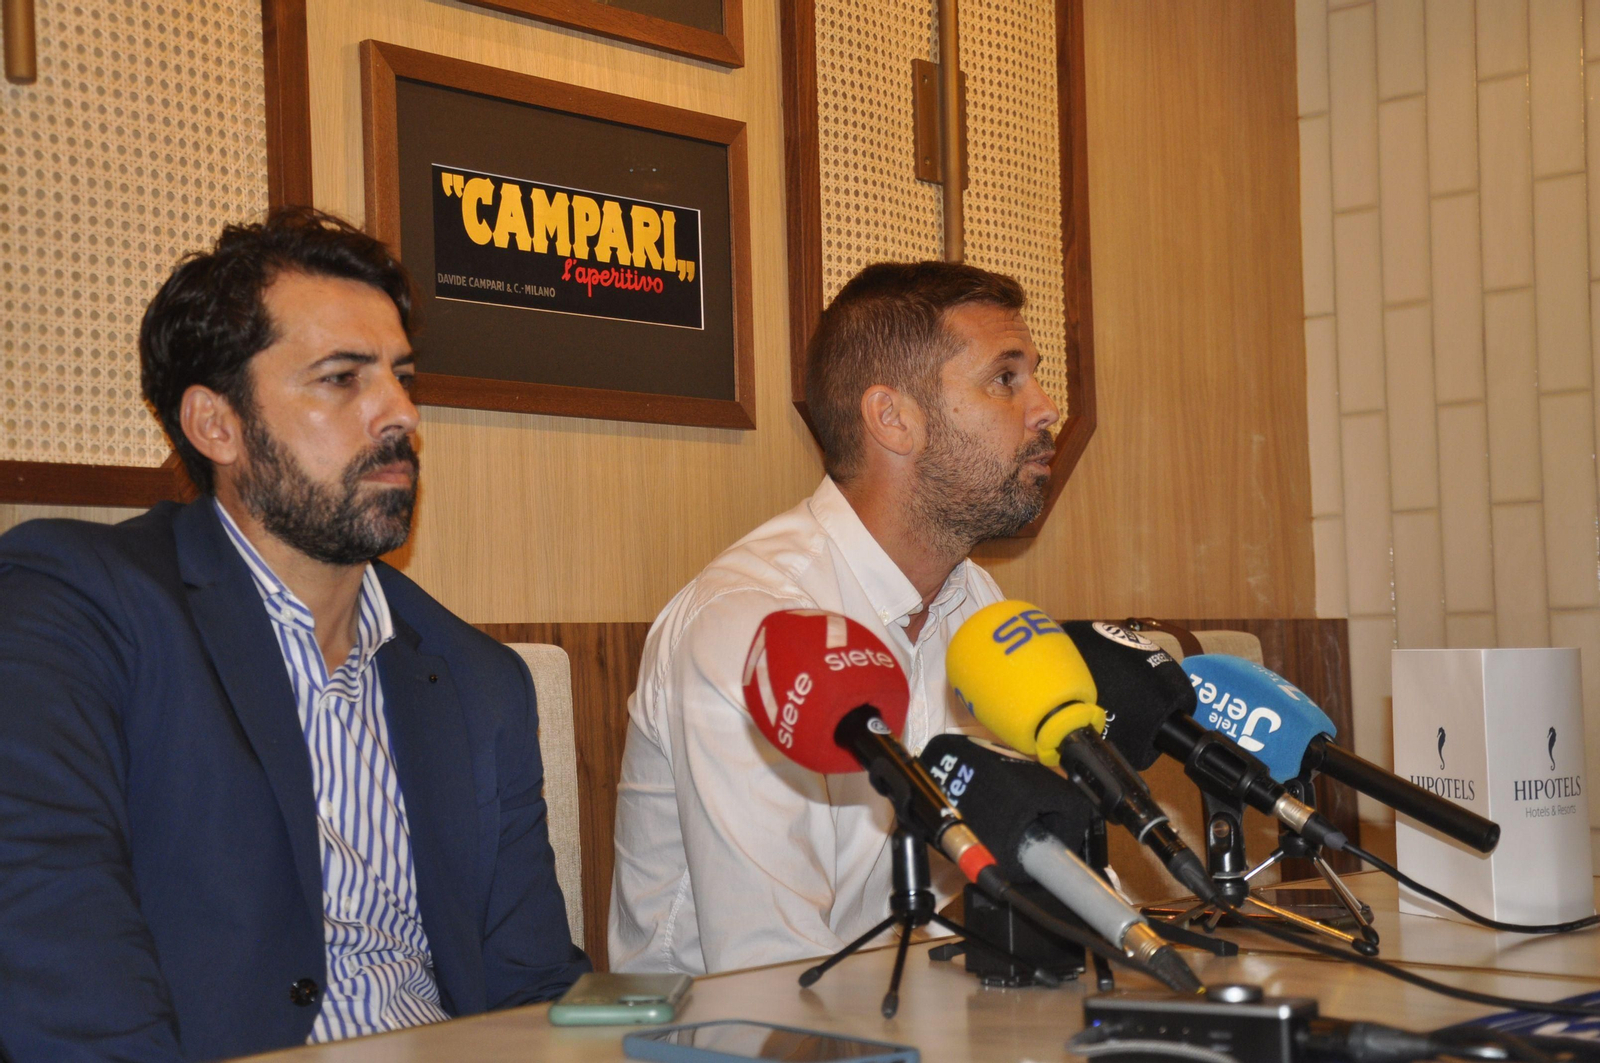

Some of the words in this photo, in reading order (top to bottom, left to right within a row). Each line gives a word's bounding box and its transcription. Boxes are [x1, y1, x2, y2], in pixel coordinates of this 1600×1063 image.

[437, 272, 467, 287] DAVIDE
[468, 277, 505, 291] CAMPARI
[506, 283, 513, 293] &
[561, 258, 663, 298] l'aperitivo
[824, 648, 895, 671] siete
[777, 672, 813, 749] siete
[1189, 673, 1282, 752] Jerez
[1208, 711, 1238, 738] Tele
[1514, 775, 1581, 801] HIPOTELS
[1525, 806, 1550, 818] Hotels
[1551, 805, 1556, 816] &
[1557, 804, 1577, 815] Resorts
